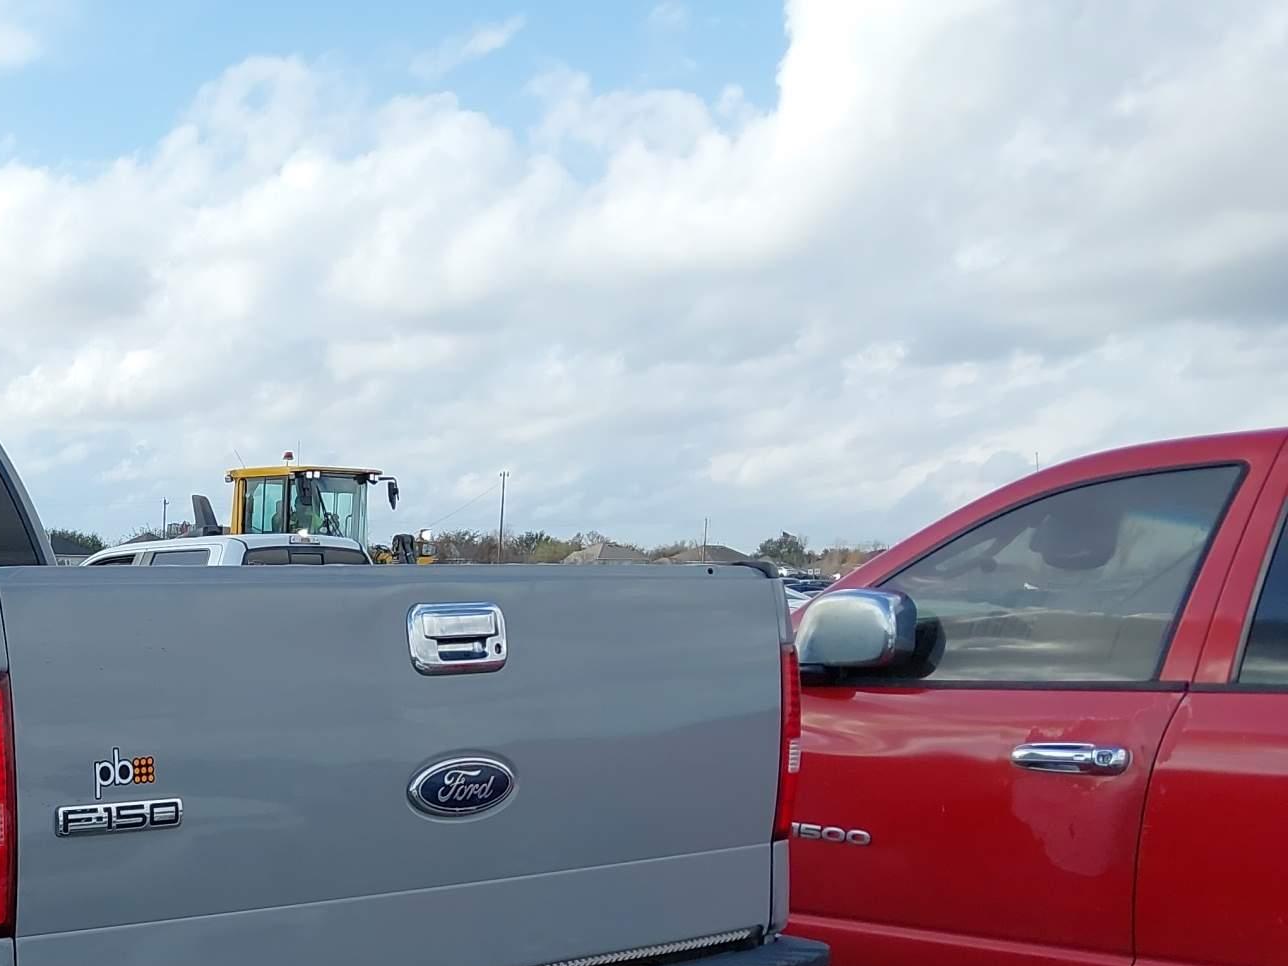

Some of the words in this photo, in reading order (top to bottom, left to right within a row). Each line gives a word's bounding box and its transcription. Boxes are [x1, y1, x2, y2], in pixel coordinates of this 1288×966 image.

[438, 769, 495, 803] Ford
[57, 799, 183, 835] F-150
[792, 822, 871, 845] 1500
